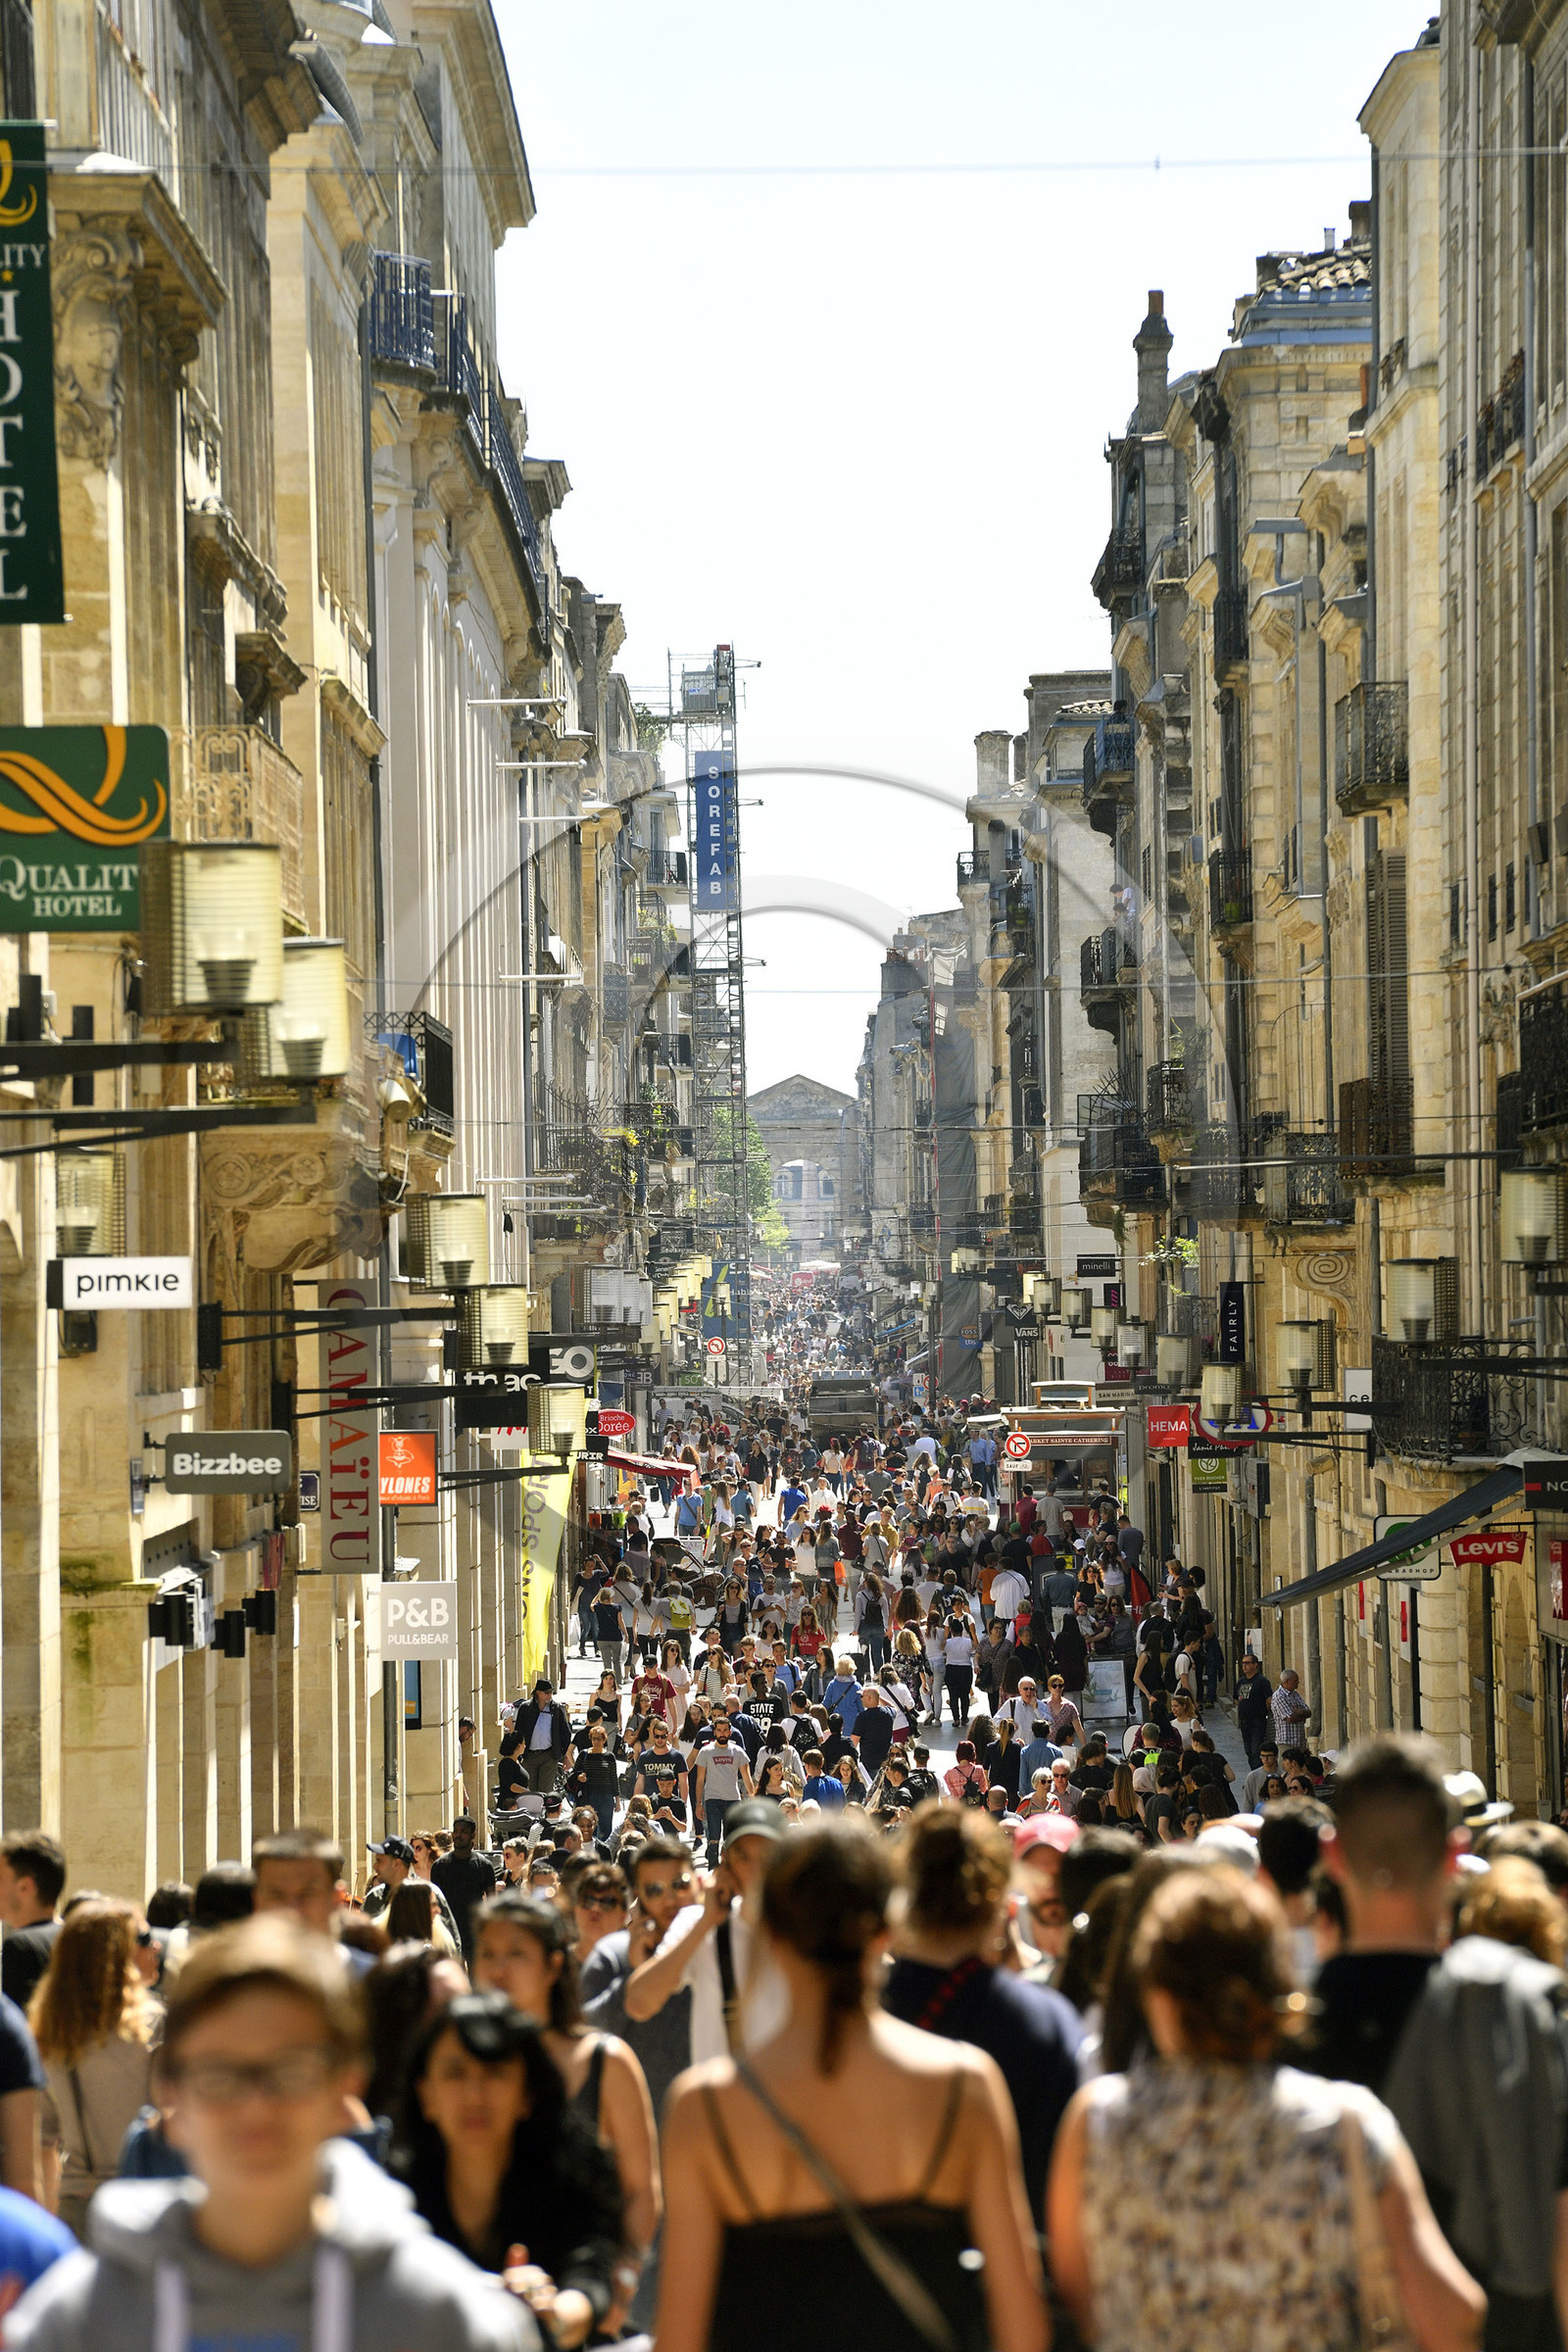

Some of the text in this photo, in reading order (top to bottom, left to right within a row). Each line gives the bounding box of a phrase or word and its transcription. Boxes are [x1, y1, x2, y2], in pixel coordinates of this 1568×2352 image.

[708, 765, 722, 895] SOREFAB
[0, 855, 139, 902] QUALIT
[32, 895, 122, 917] HOTEL
[1082, 1261, 1110, 1270] minelli
[76, 1271, 180, 1298] pimkie
[1014, 1327, 1039, 1338] VANS
[1229, 1298, 1238, 1352] FAIRLY
[1151, 1421, 1188, 1432] HEMA
[576, 1451, 604, 1460] URIR
[173, 1453, 283, 1476] Bizzbee
[380, 1477, 431, 1494] YLONES
[387, 1597, 450, 1629] P&B
[387, 1634, 449, 1645] PULL&BEAR
[750, 1703, 774, 1714] STATE
[644, 1763, 676, 1772] TOMMY
